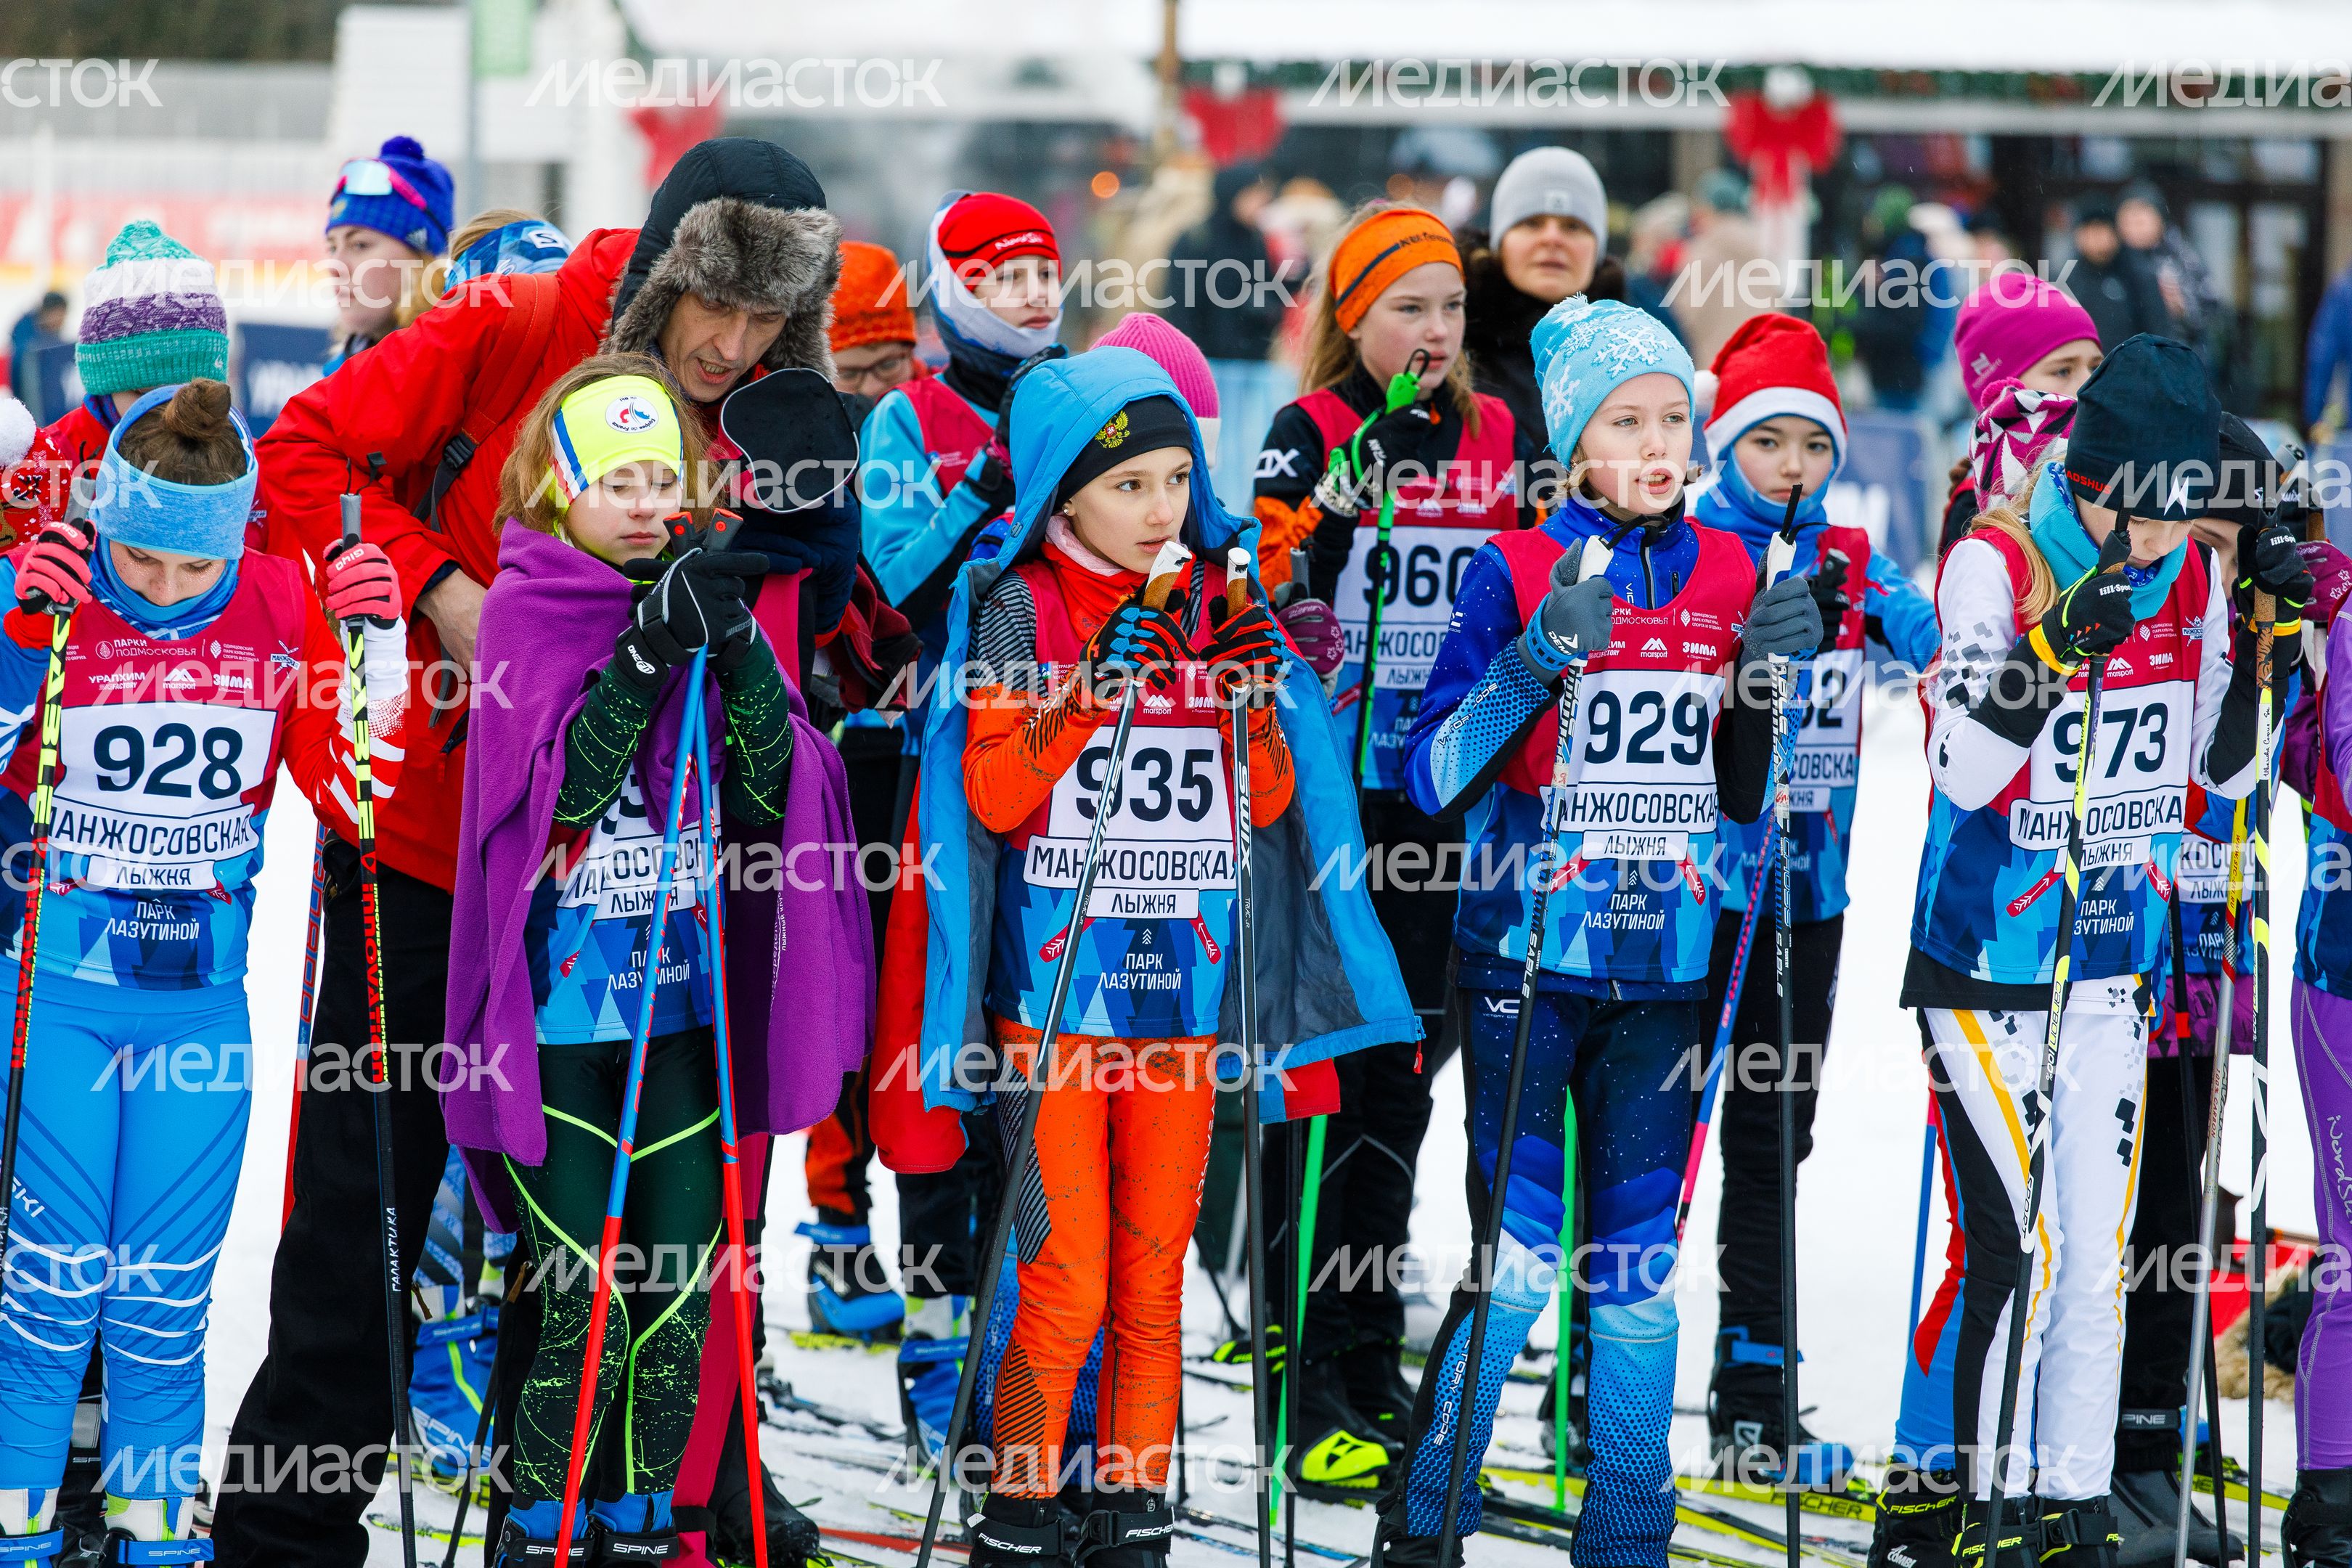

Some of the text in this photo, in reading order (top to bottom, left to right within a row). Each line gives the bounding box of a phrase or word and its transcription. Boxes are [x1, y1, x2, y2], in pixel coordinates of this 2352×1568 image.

[2067, 470, 2112, 495] ADSHUS
[1682, 641, 1717, 657] ЗИМА
[2149, 652, 2173, 666] ЗИМА
[2107, 668, 2133, 678] marsport
[34, 614, 70, 825] SABLE
[1584, 690, 1710, 765] 929
[348, 628, 375, 839] SABLE
[2053, 702, 2168, 783] 973
[94, 722, 243, 799] 928
[1076, 748, 1214, 822] 935
[1091, 754, 1123, 867] SWIX
[1238, 761, 1251, 877] SWIX
[1604, 834, 1666, 856] ЛЫЖНЯ
[116, 866, 192, 886] ЛЫЖНЯ
[136, 901, 176, 920] ПАРК
[1111, 891, 1177, 915] ЛЫЖНЯ
[1610, 894, 1646, 910] ПАРК
[2080, 899, 2118, 917] ПАРК
[105, 917, 200, 941] ЛАЗУТИНОЙ
[1583, 909, 1665, 931] ЛАЗУТИНОЙ
[2073, 911, 2134, 936] ЗУТИНОЙ
[1125, 952, 1163, 971] ПАРК
[1522, 931, 1538, 999] SABLE
[1098, 969, 1181, 990] ЛАЗУТИНОЙ
[1433, 1400, 1453, 1446] CODE
[2122, 1414, 2166, 1425] PINE
[147, 1548, 202, 1557] SPINE
[613, 1543, 669, 1555] SPINE
[978, 1532, 1042, 1554] FISCHER
